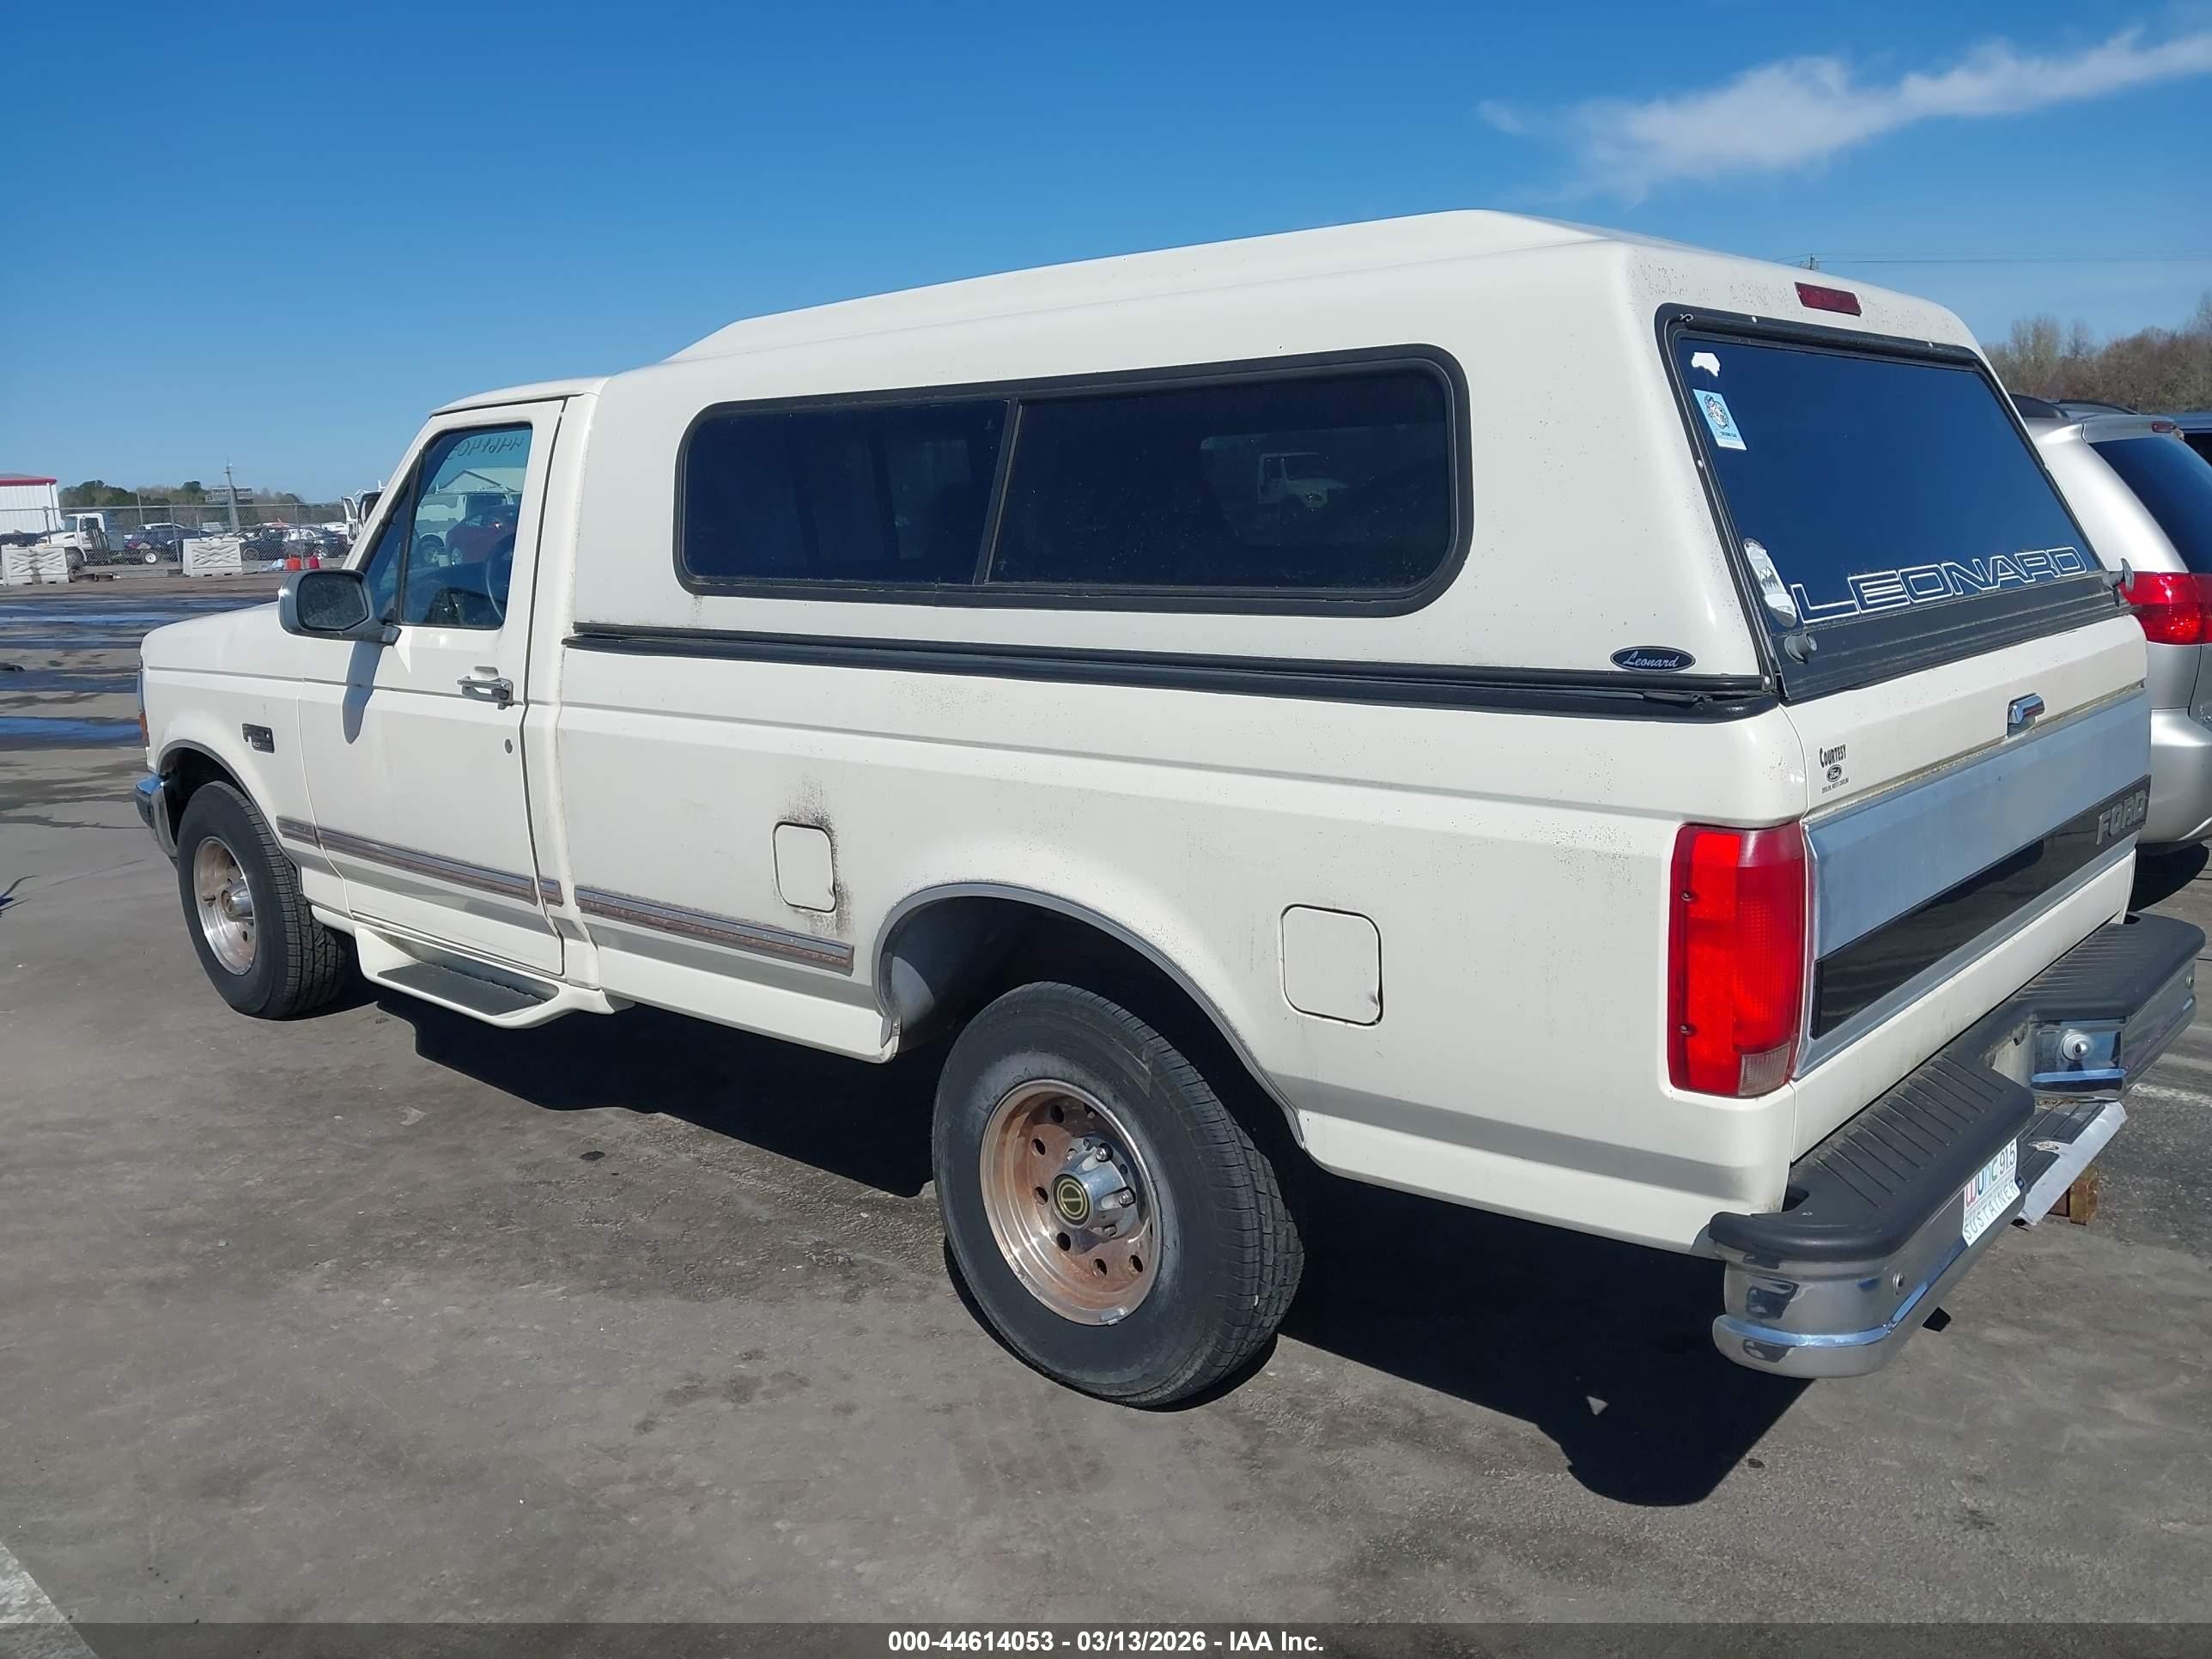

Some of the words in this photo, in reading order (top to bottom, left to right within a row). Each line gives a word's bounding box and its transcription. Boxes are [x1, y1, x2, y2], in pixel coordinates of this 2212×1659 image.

[1791, 547, 2087, 623] LEONARD
[1623, 650, 1680, 667] Leonard
[2096, 790, 2146, 845] FORD
[1964, 1180, 2019, 1240] SUSTAINER
